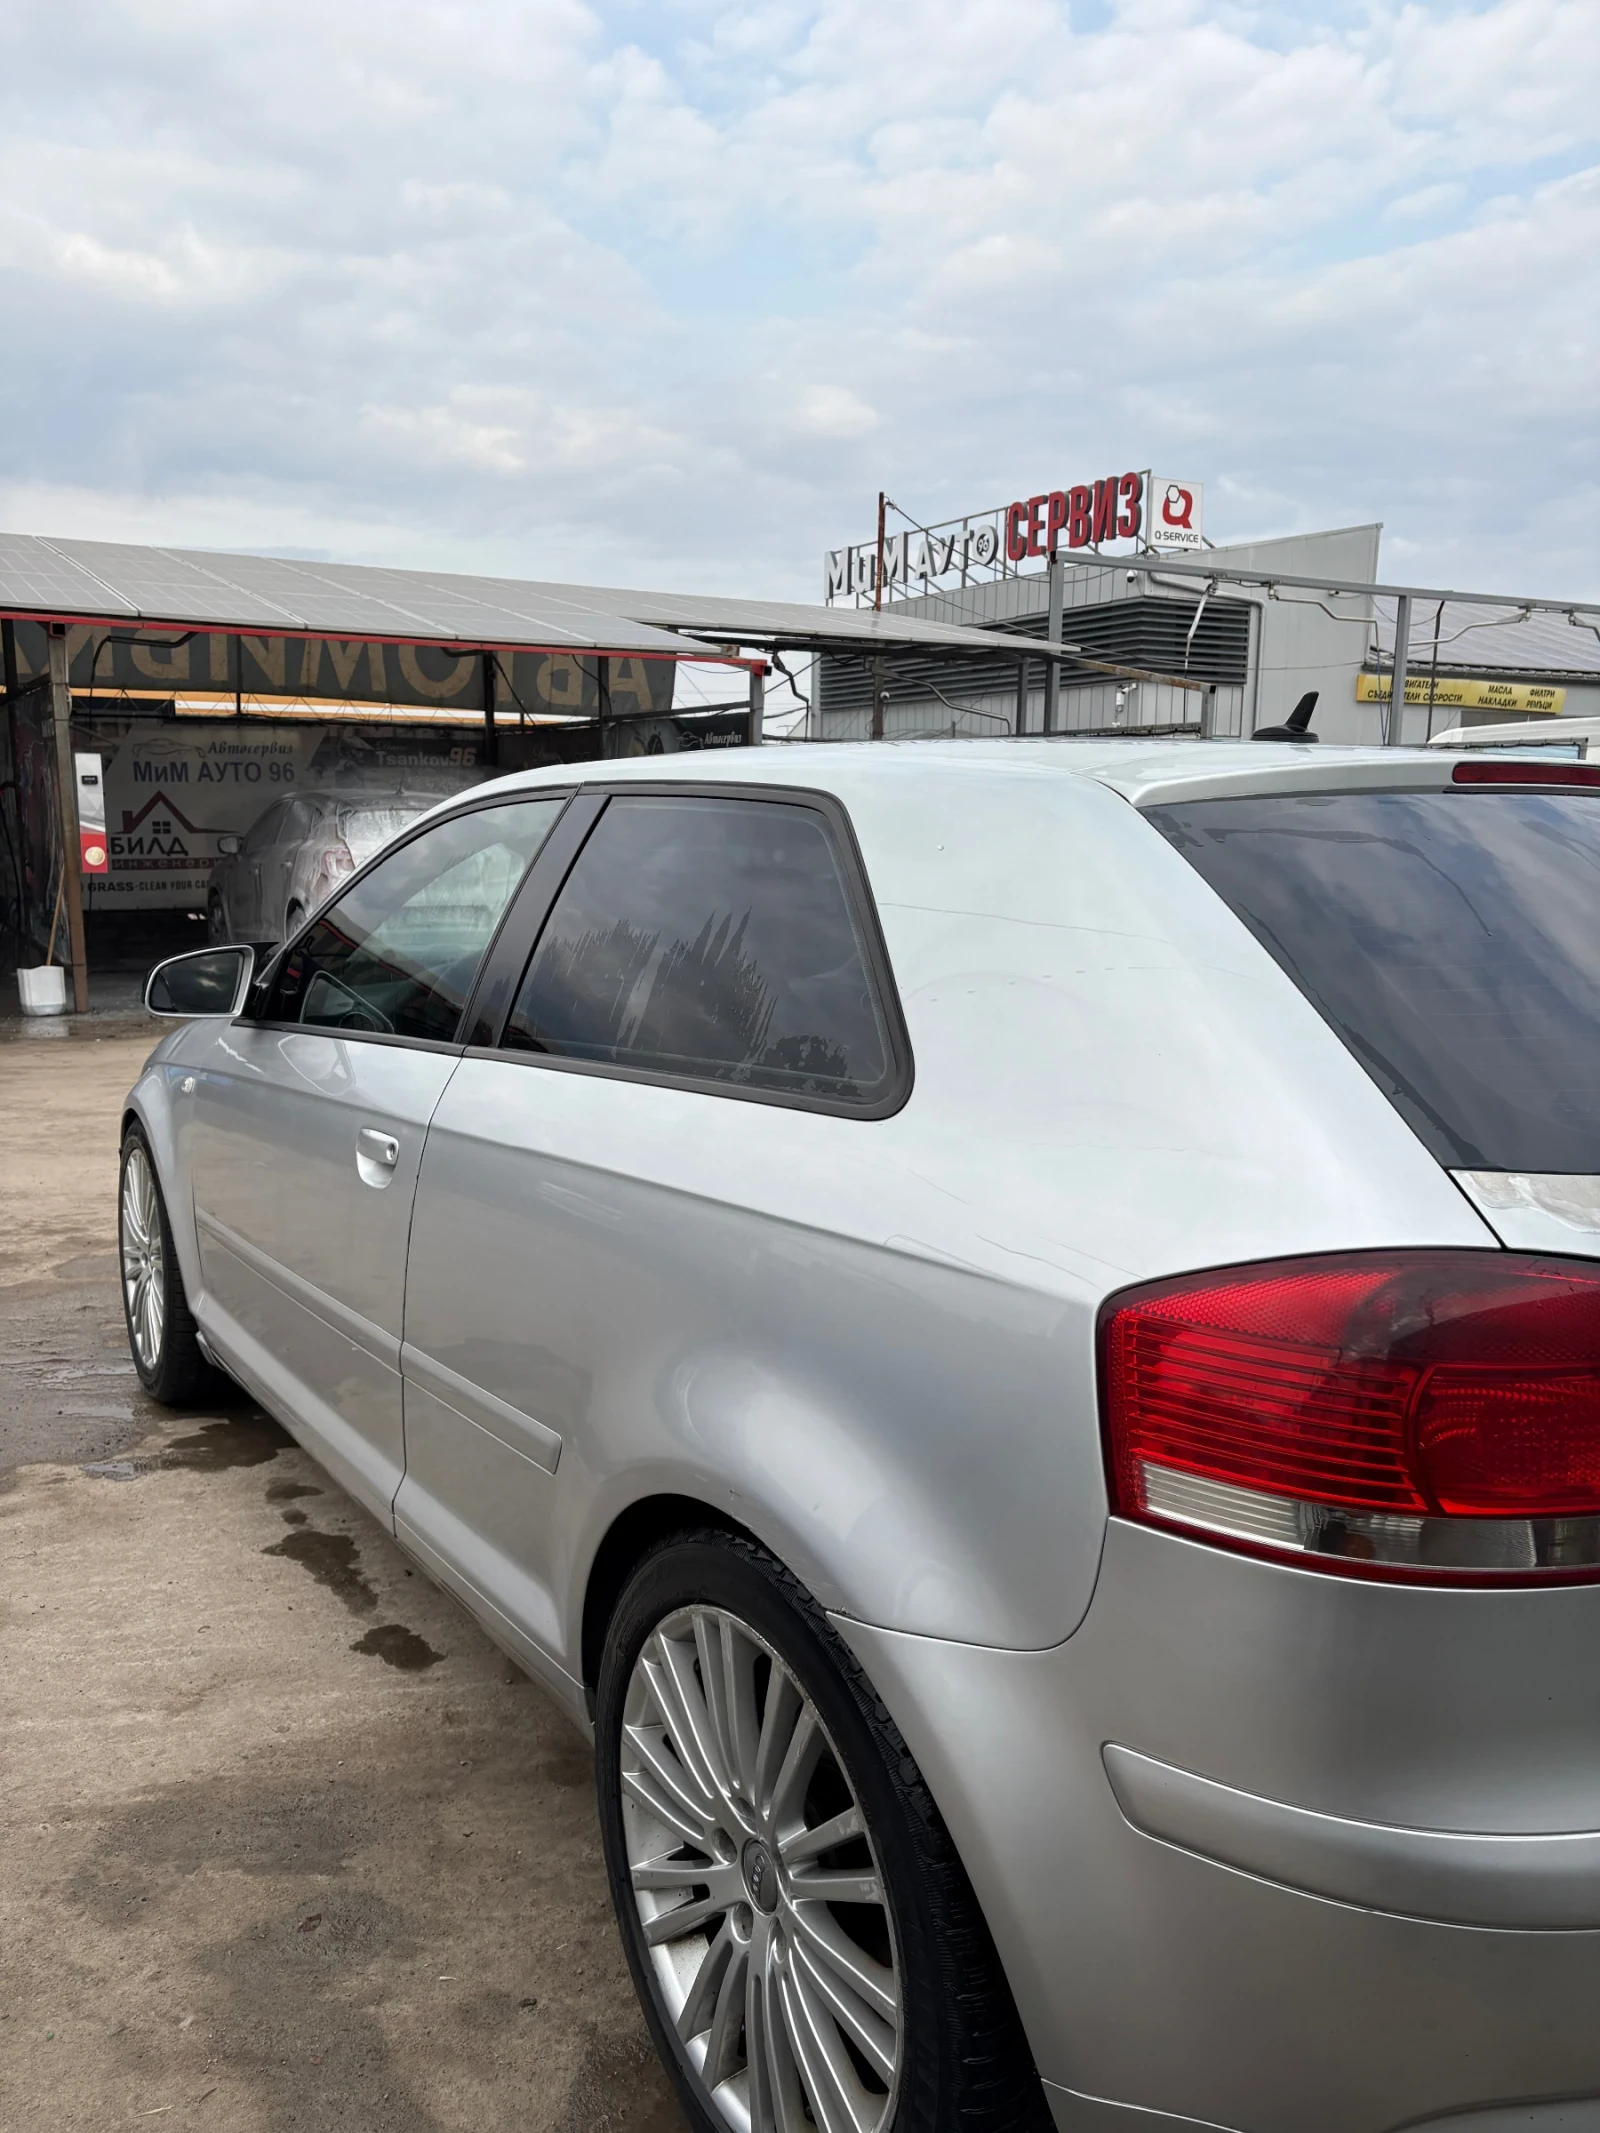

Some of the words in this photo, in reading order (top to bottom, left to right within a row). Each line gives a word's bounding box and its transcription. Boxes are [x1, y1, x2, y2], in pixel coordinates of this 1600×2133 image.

[915, 525, 999, 580] АУТО
[1007, 472, 1144, 561] СЕРВИЗ
[1154, 530, 1199, 543] Q-SERVICE
[976, 537, 990, 554] 96
[1404, 679, 1439, 690] ВИГАТЕИ
[1487, 684, 1513, 696] МАСЛА
[1422, 692, 1463, 703] СОРОСТИ
[1529, 688, 1556, 698] ФИЛТРИ
[1477, 695, 1518, 708] НАКЛАДКИ
[1525, 699, 1553, 711] РЕМЪЦИ
[208, 741, 294, 758] Автосервиз
[133, 760, 190, 783] МиМ
[197, 761, 262, 783] АУТО
[269, 761, 295, 783] 96
[170, 879, 193, 890] YOUR
